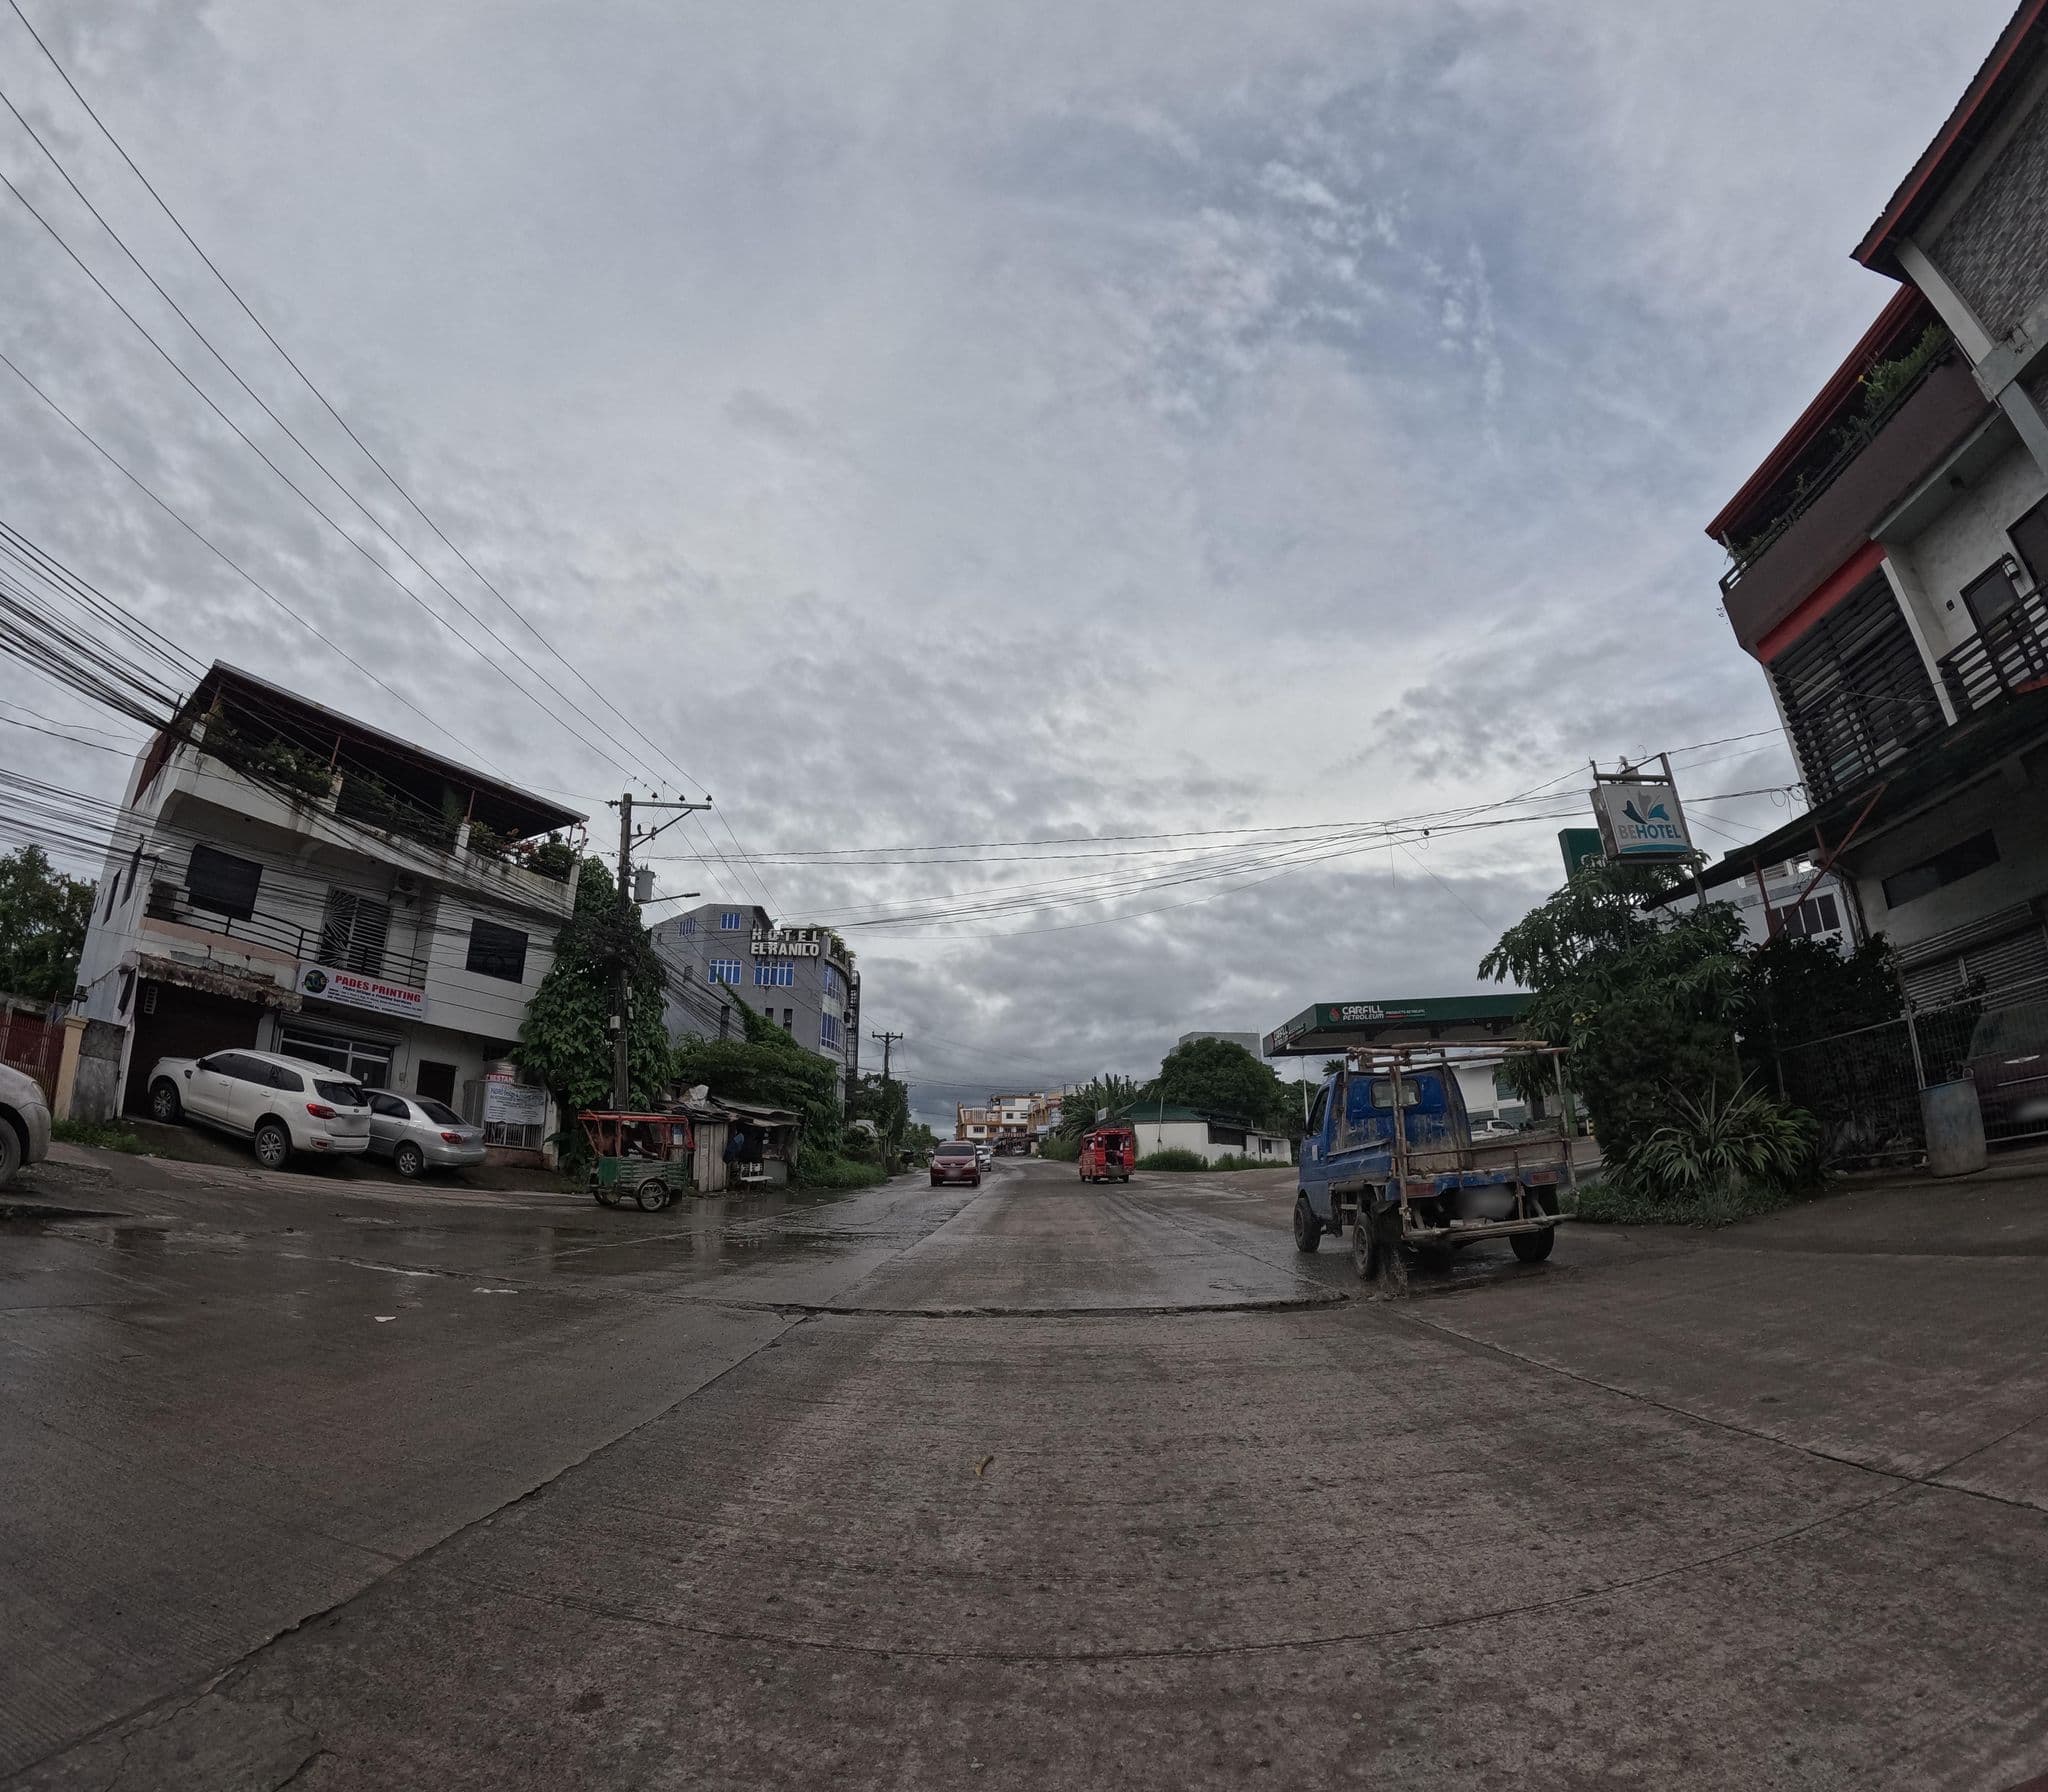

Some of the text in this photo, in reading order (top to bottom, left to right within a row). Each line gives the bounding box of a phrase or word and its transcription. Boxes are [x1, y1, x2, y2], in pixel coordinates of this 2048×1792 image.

[1619, 825, 1681, 838] BEHOTEL
[752, 928, 819, 942] HOTEL
[335, 975, 369, 990] PADES
[371, 984, 422, 1003] PRINTING
[1342, 1004, 1384, 1015] CARFILL
[1342, 1013, 1384, 1022] PETROLEUM
